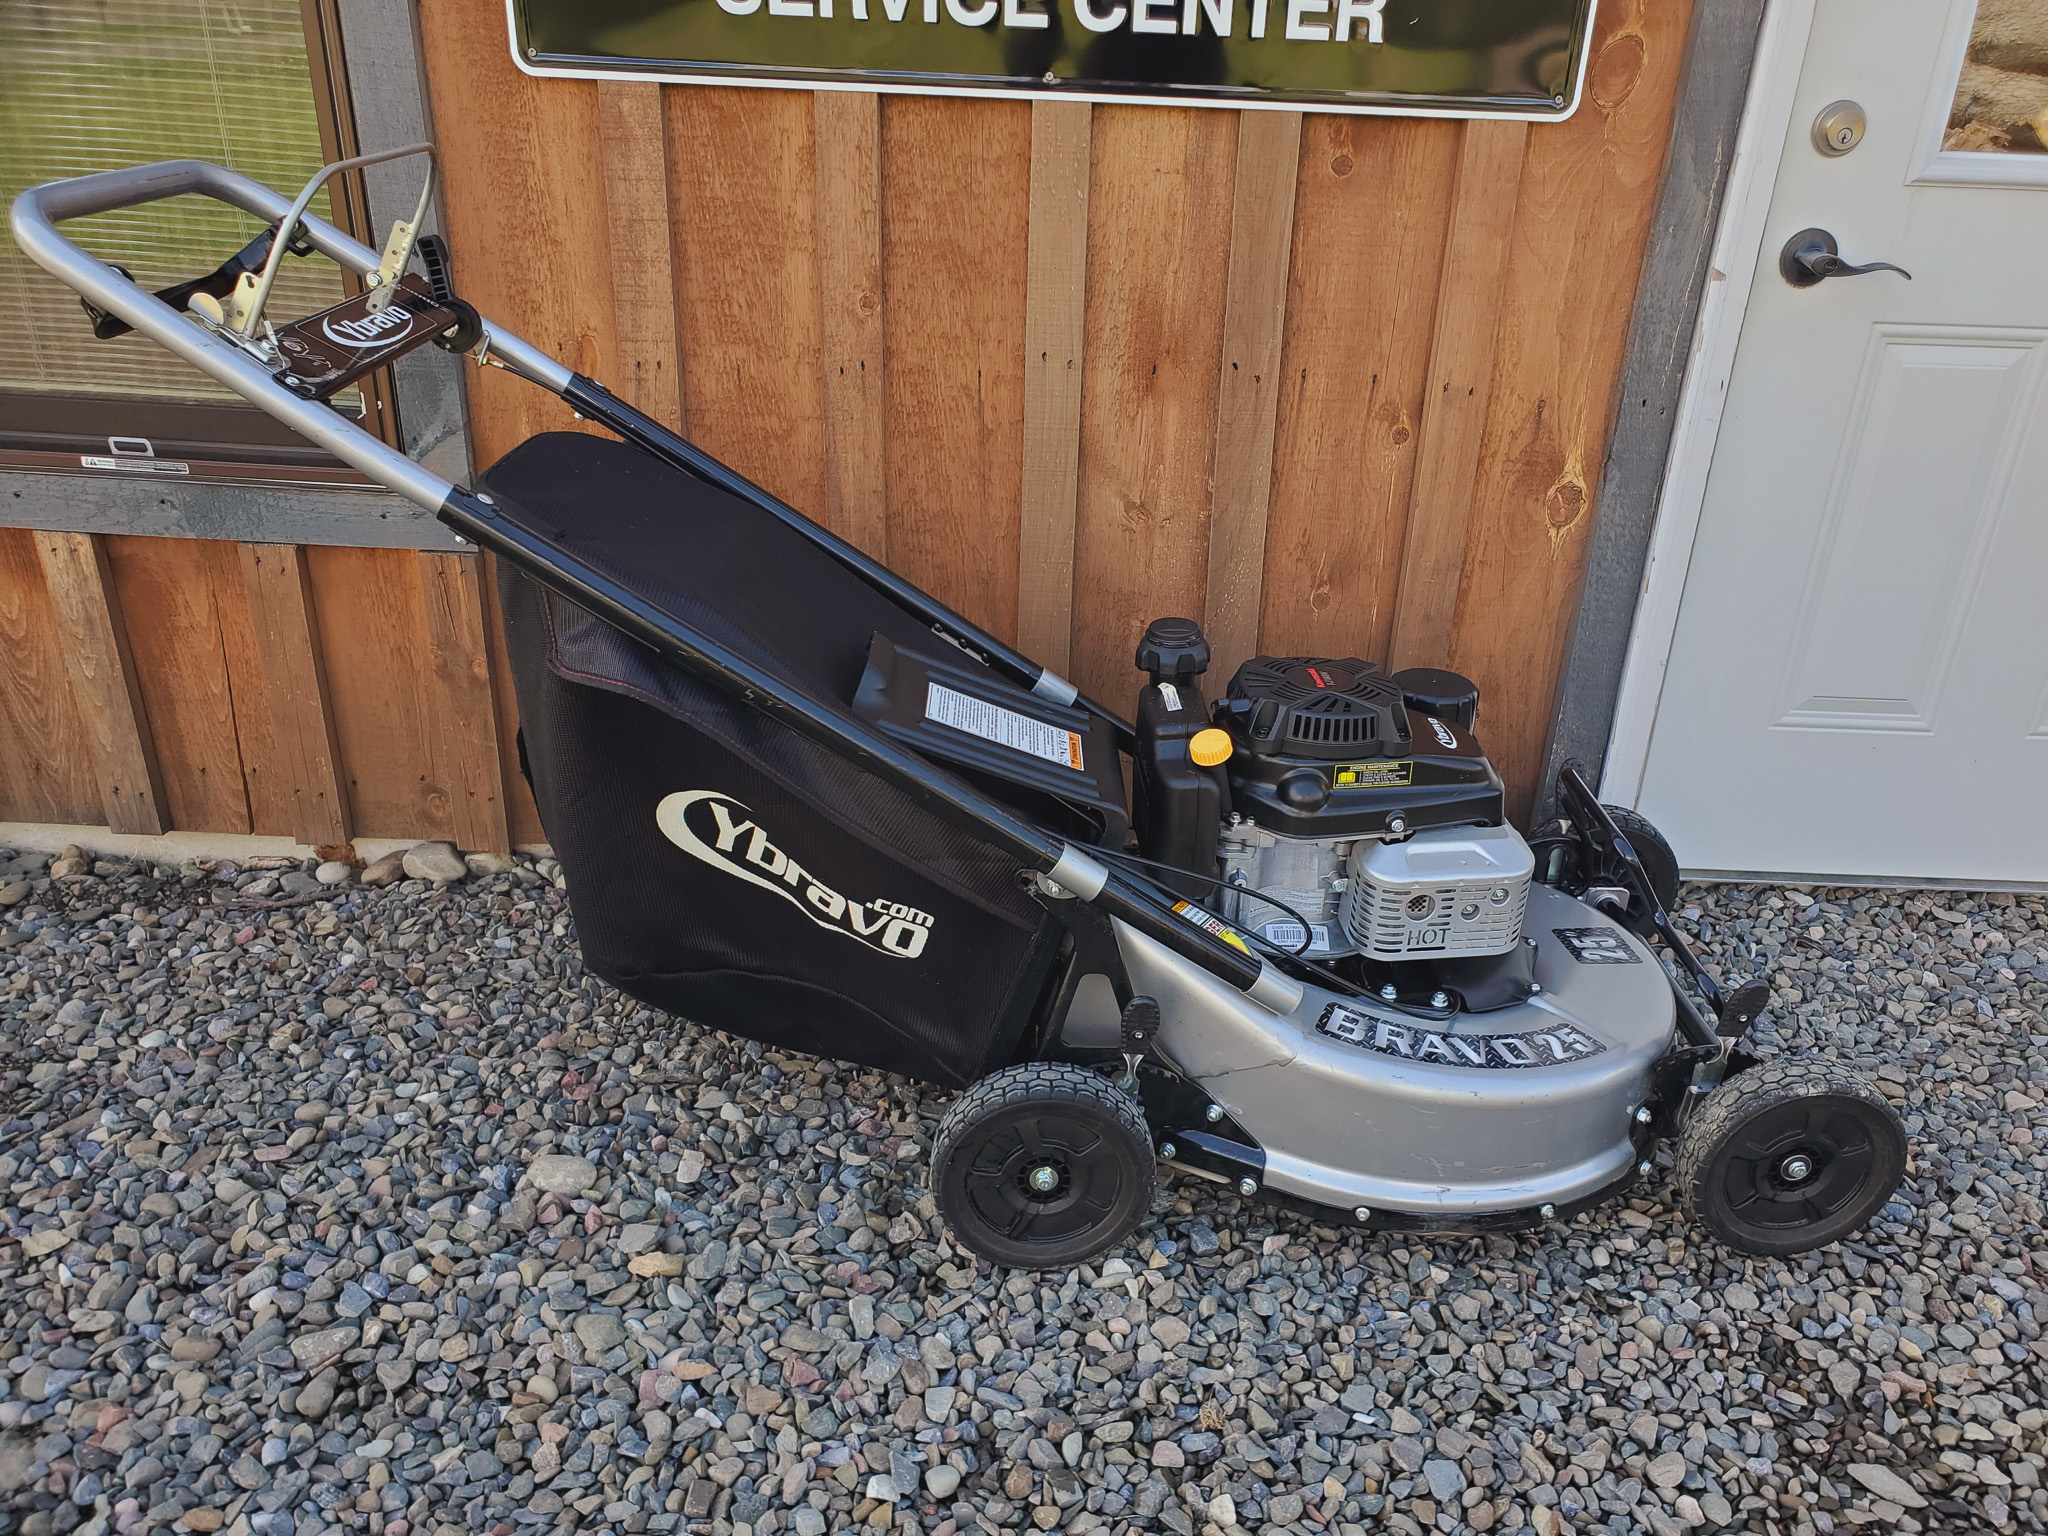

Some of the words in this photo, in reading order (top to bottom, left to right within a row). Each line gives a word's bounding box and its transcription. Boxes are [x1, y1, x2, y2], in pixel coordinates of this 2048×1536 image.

[1407, 927, 1452, 947] HOT
[1324, 1007, 1542, 1065] BRAVO
[1534, 1027, 1598, 1060] 25
